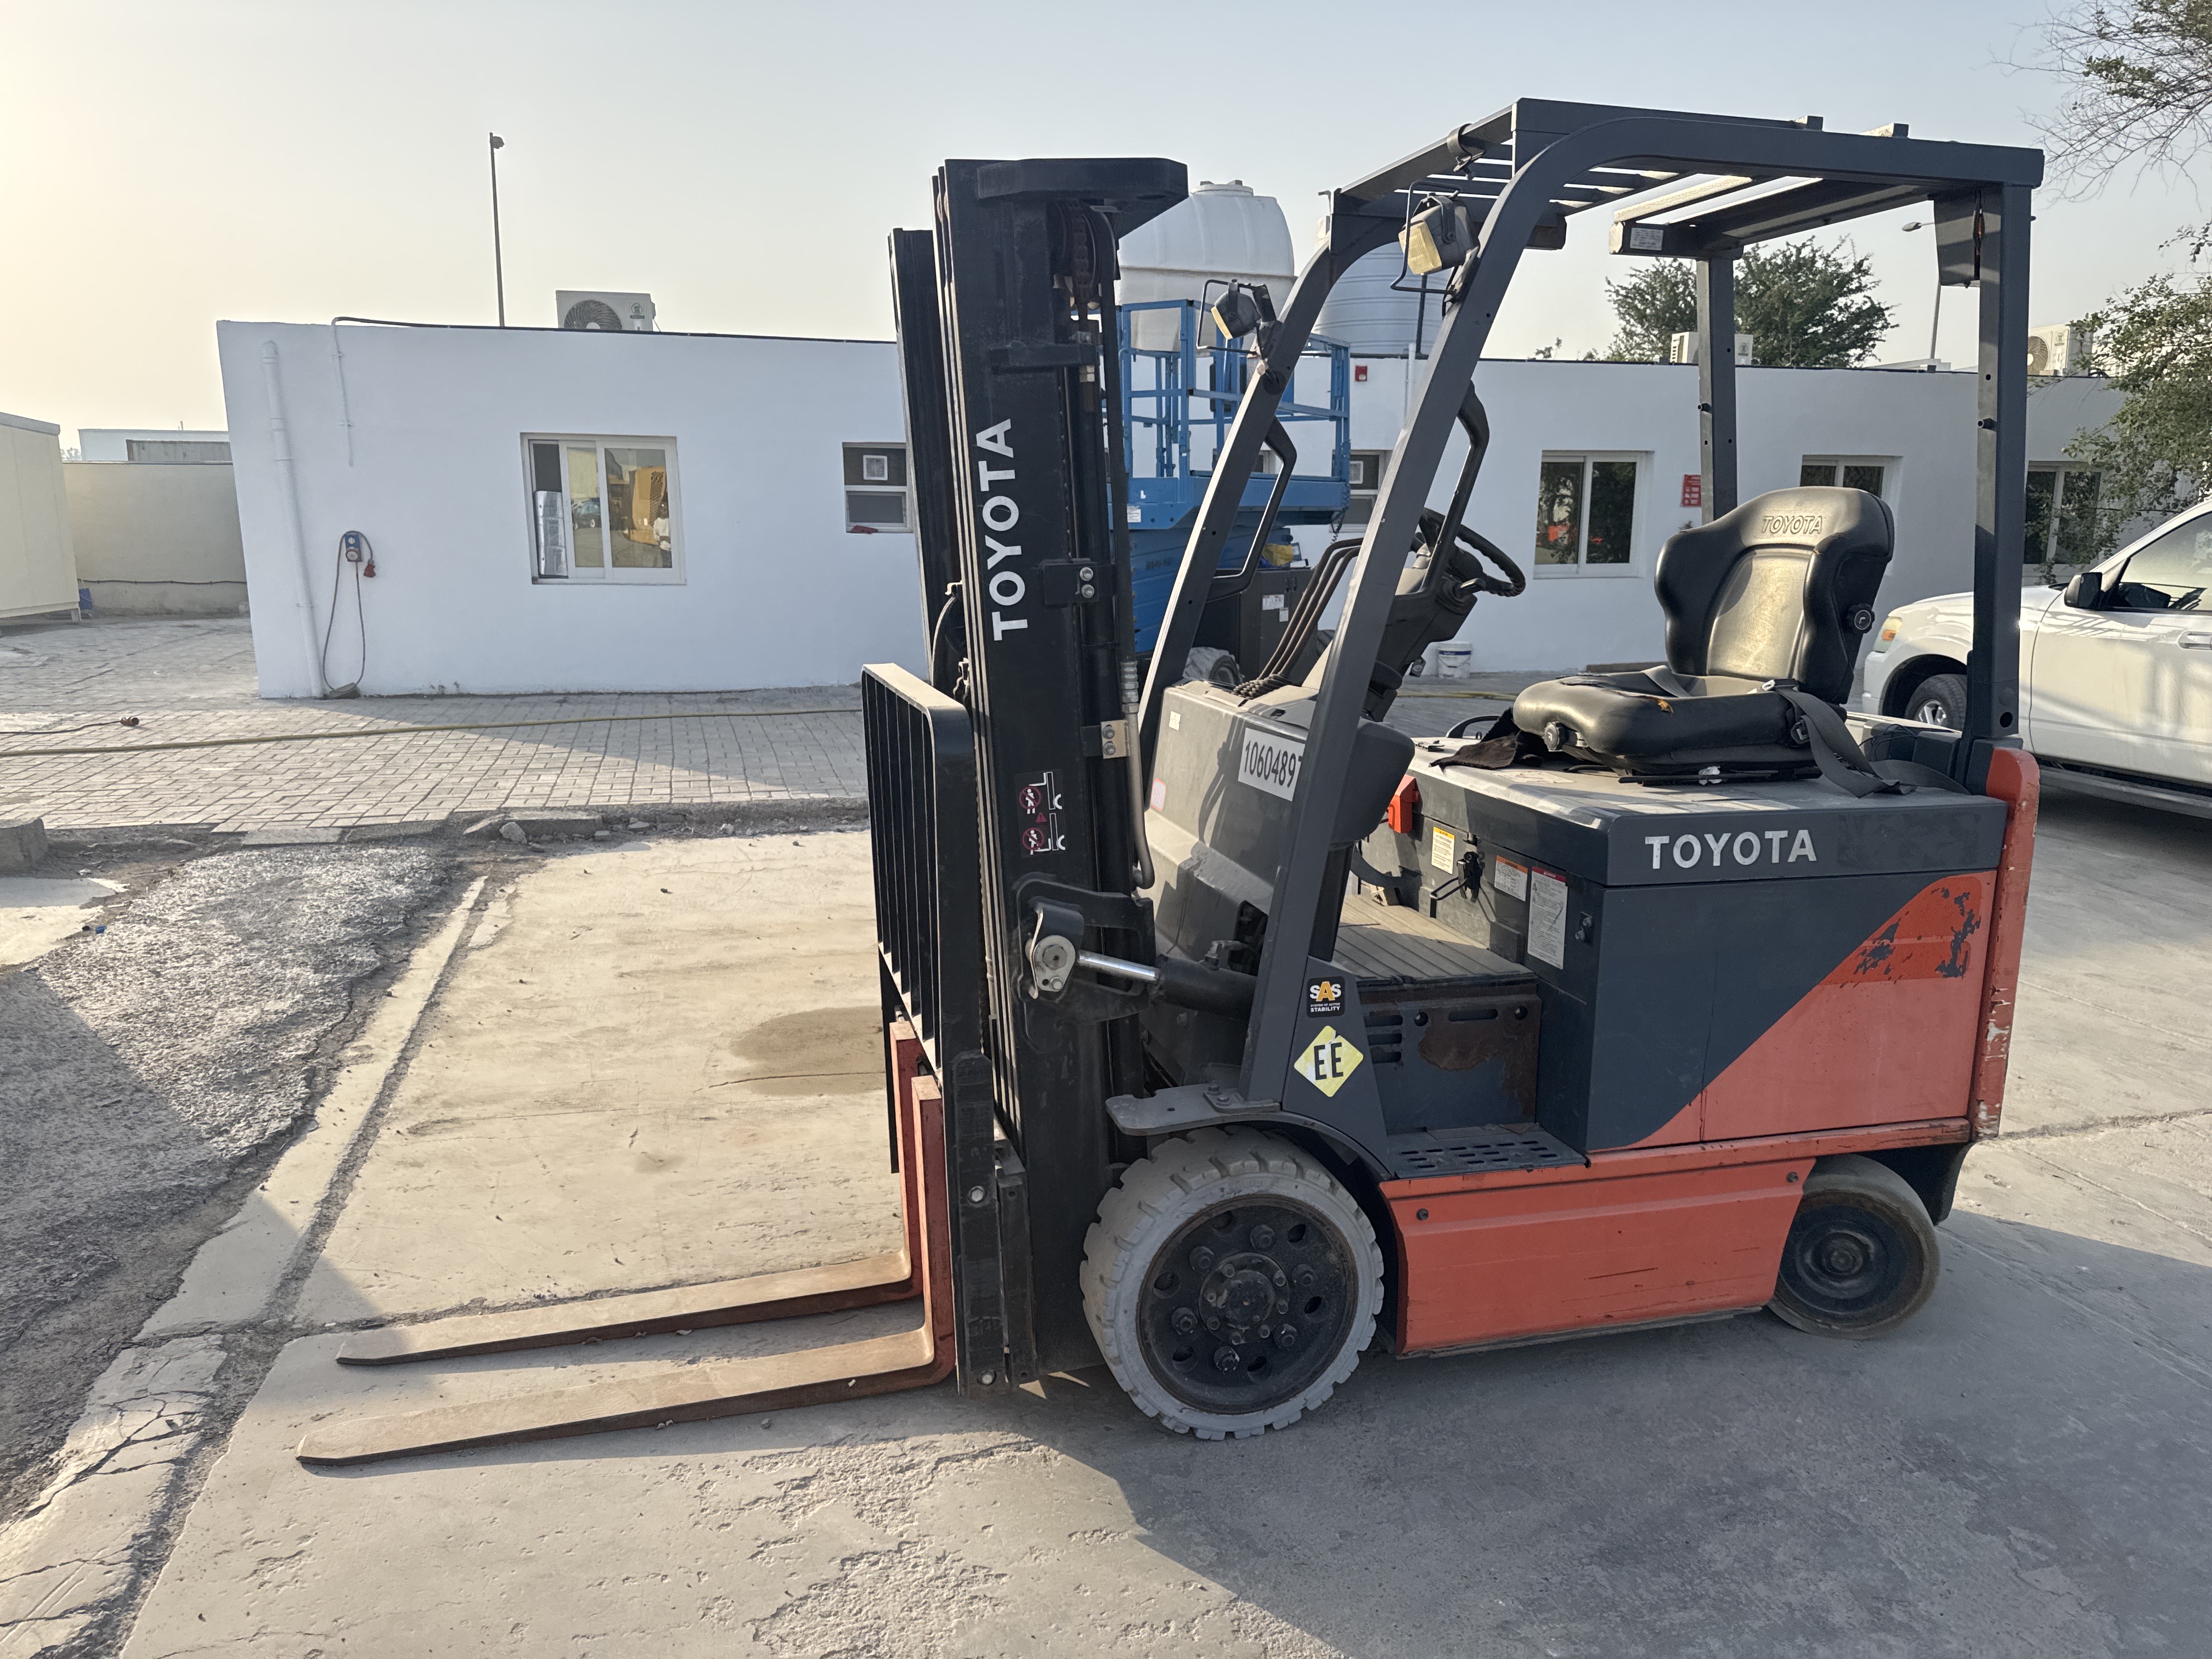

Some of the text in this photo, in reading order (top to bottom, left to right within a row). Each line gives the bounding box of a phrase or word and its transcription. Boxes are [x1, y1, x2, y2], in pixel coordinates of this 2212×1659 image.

[976, 419, 1028, 641] TOYOTA
[1762, 515, 1822, 534] TOYOTA
[1244, 741, 1302, 788] 1060489
[1645, 830, 1817, 870] TOYOTA
[1310, 981, 1341, 1002] SAS
[1314, 1042, 1343, 1080] EE
